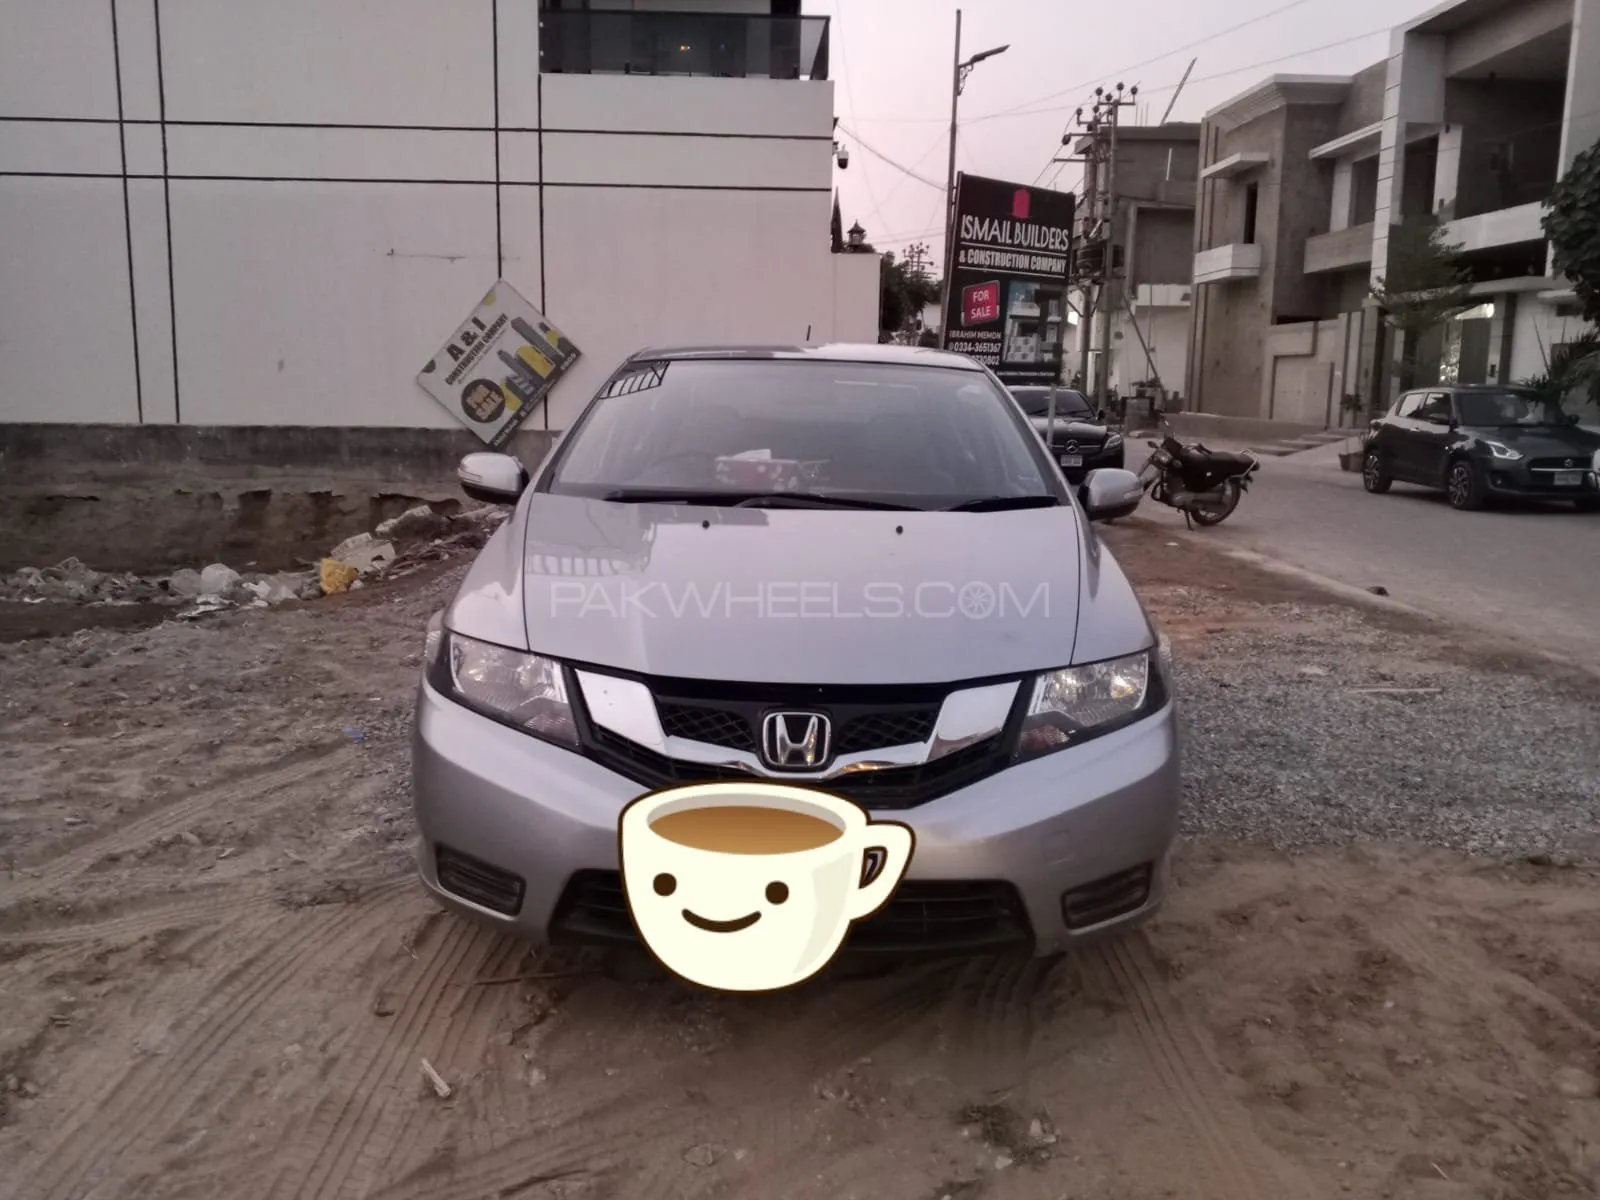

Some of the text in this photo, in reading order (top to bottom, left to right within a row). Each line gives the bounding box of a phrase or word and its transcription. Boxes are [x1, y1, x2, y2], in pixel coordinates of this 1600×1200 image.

[960, 214, 1069, 251] ISMAIL BUILDERS
[959, 249, 1067, 273] & CONSTRUCTION COMPANY
[972, 290, 990, 303] FOR
[970, 306, 992, 320] SALE
[481, 312, 508, 343] COMPANY
[446, 343, 466, 362] A
[460, 330, 479, 347] &
